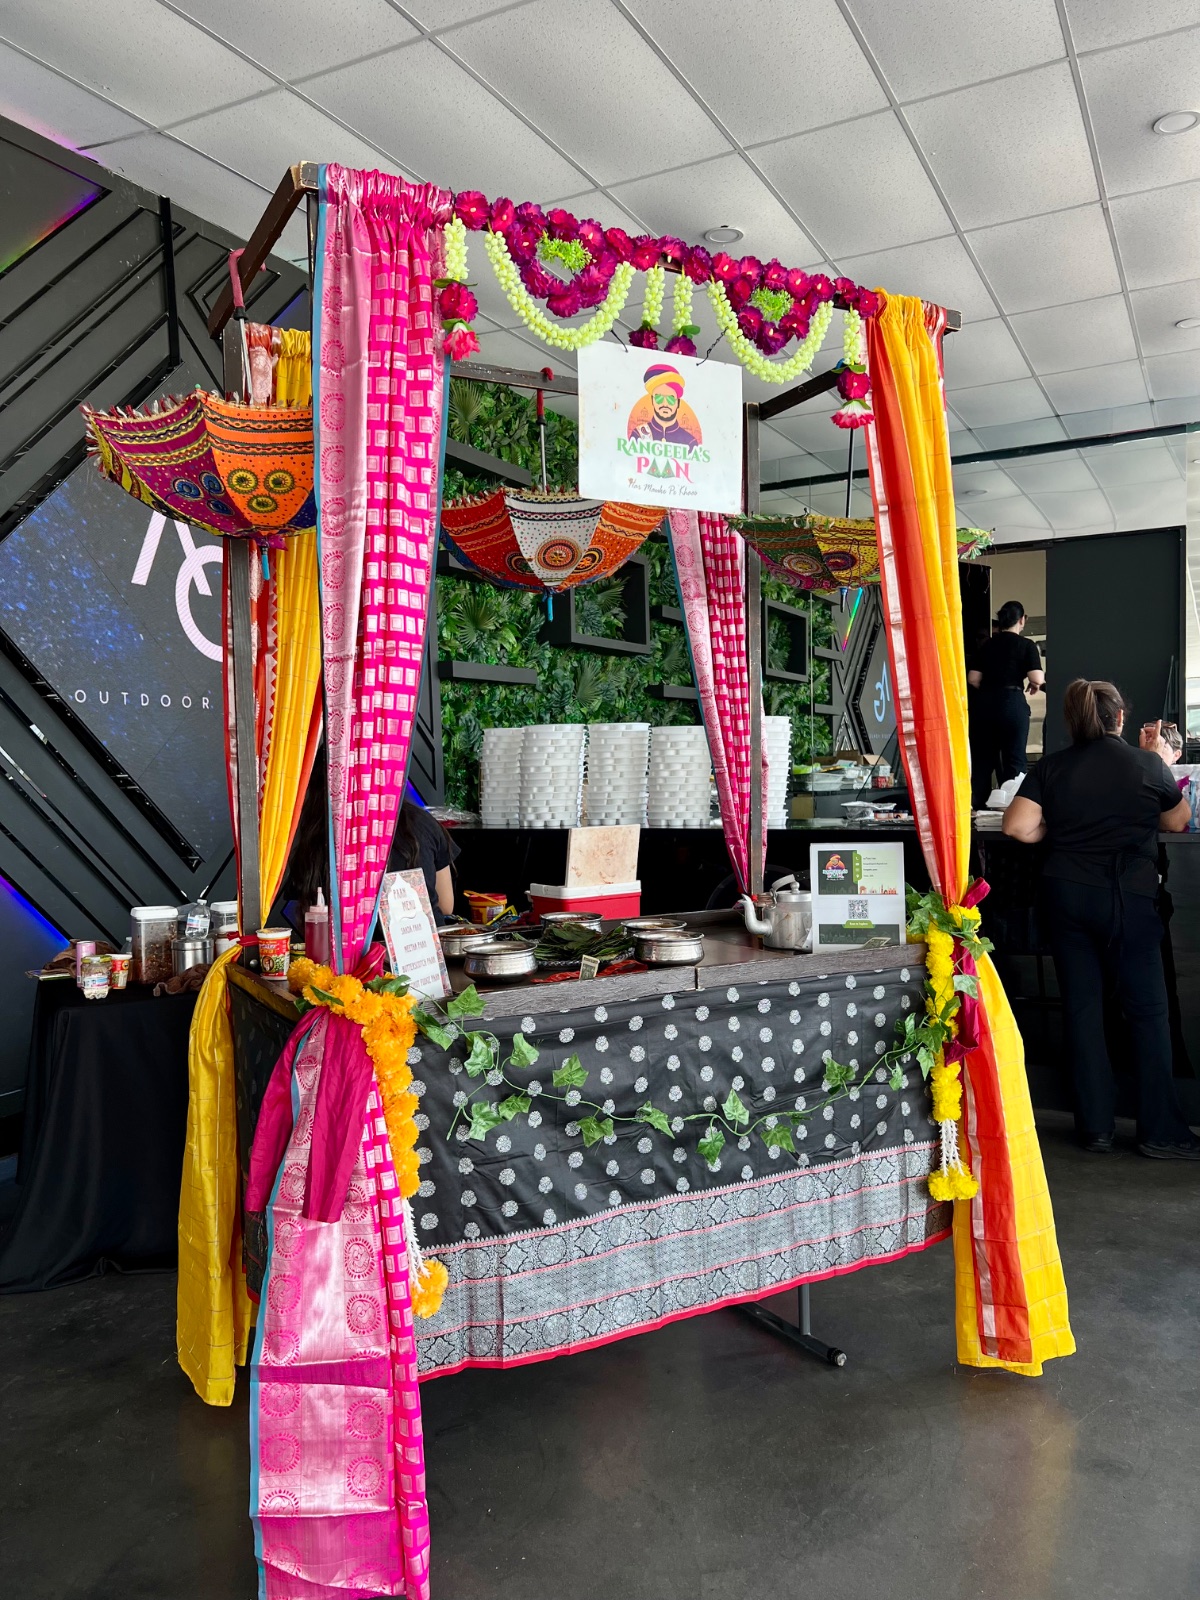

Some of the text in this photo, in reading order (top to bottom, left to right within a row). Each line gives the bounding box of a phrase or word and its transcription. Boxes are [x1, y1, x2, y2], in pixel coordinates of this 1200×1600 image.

[616, 437, 711, 464] RANGEELA'S
[636, 457, 695, 484] PAAN
[74, 689, 211, 710] OUTDOOR
[393, 888, 407, 899] PAAN
[402, 900, 415, 911] MENU
